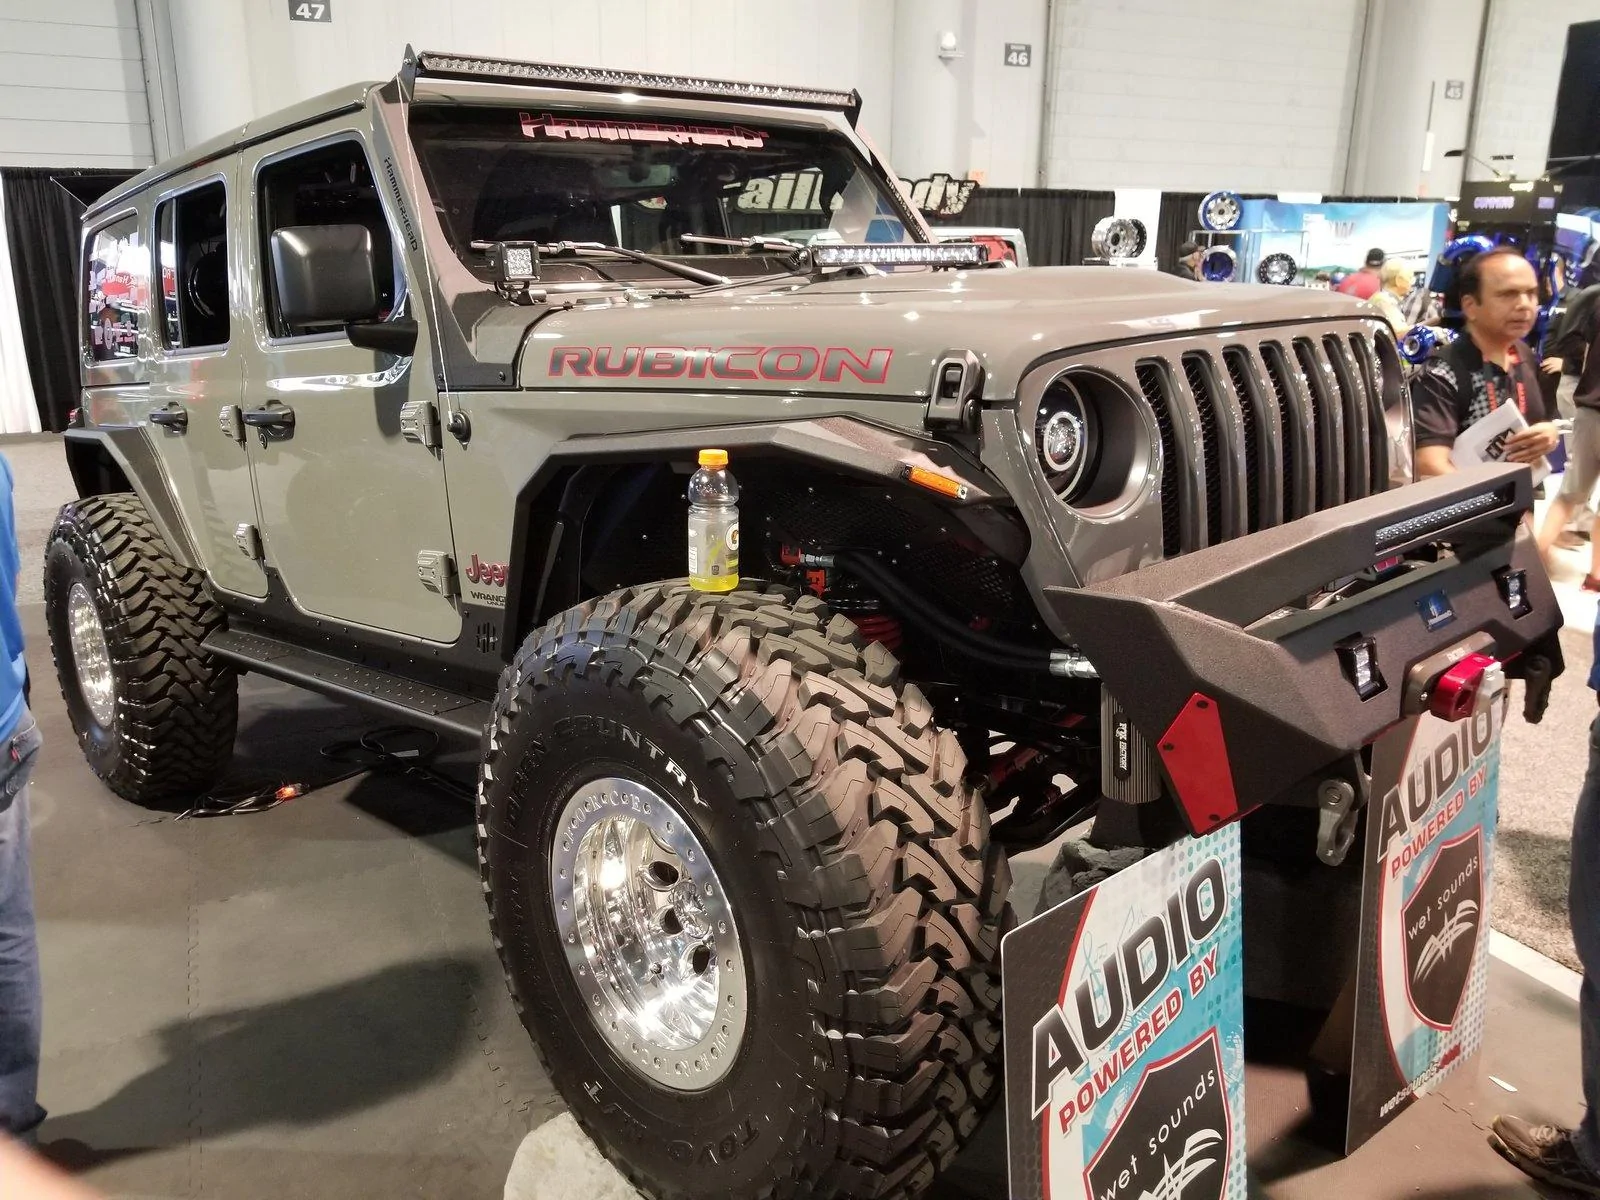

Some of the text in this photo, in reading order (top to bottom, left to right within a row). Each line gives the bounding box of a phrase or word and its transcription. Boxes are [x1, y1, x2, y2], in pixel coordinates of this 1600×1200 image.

[296, 3, 325, 19] 47
[1008, 51, 1028, 65] 46
[548, 346, 893, 384] RUBICON
[470, 590, 506, 603] WRANG
[1115, 722, 1127, 740] FOX
[1377, 703, 1493, 864] AUDIO
[1391, 763, 1487, 879] POWERED BY
[1408, 855, 1478, 940] wet sounds
[1032, 855, 1227, 1119] AUDIO
[1059, 944, 1218, 1135] POWERED BY
[1100, 1068, 1215, 1200] wet sounds
